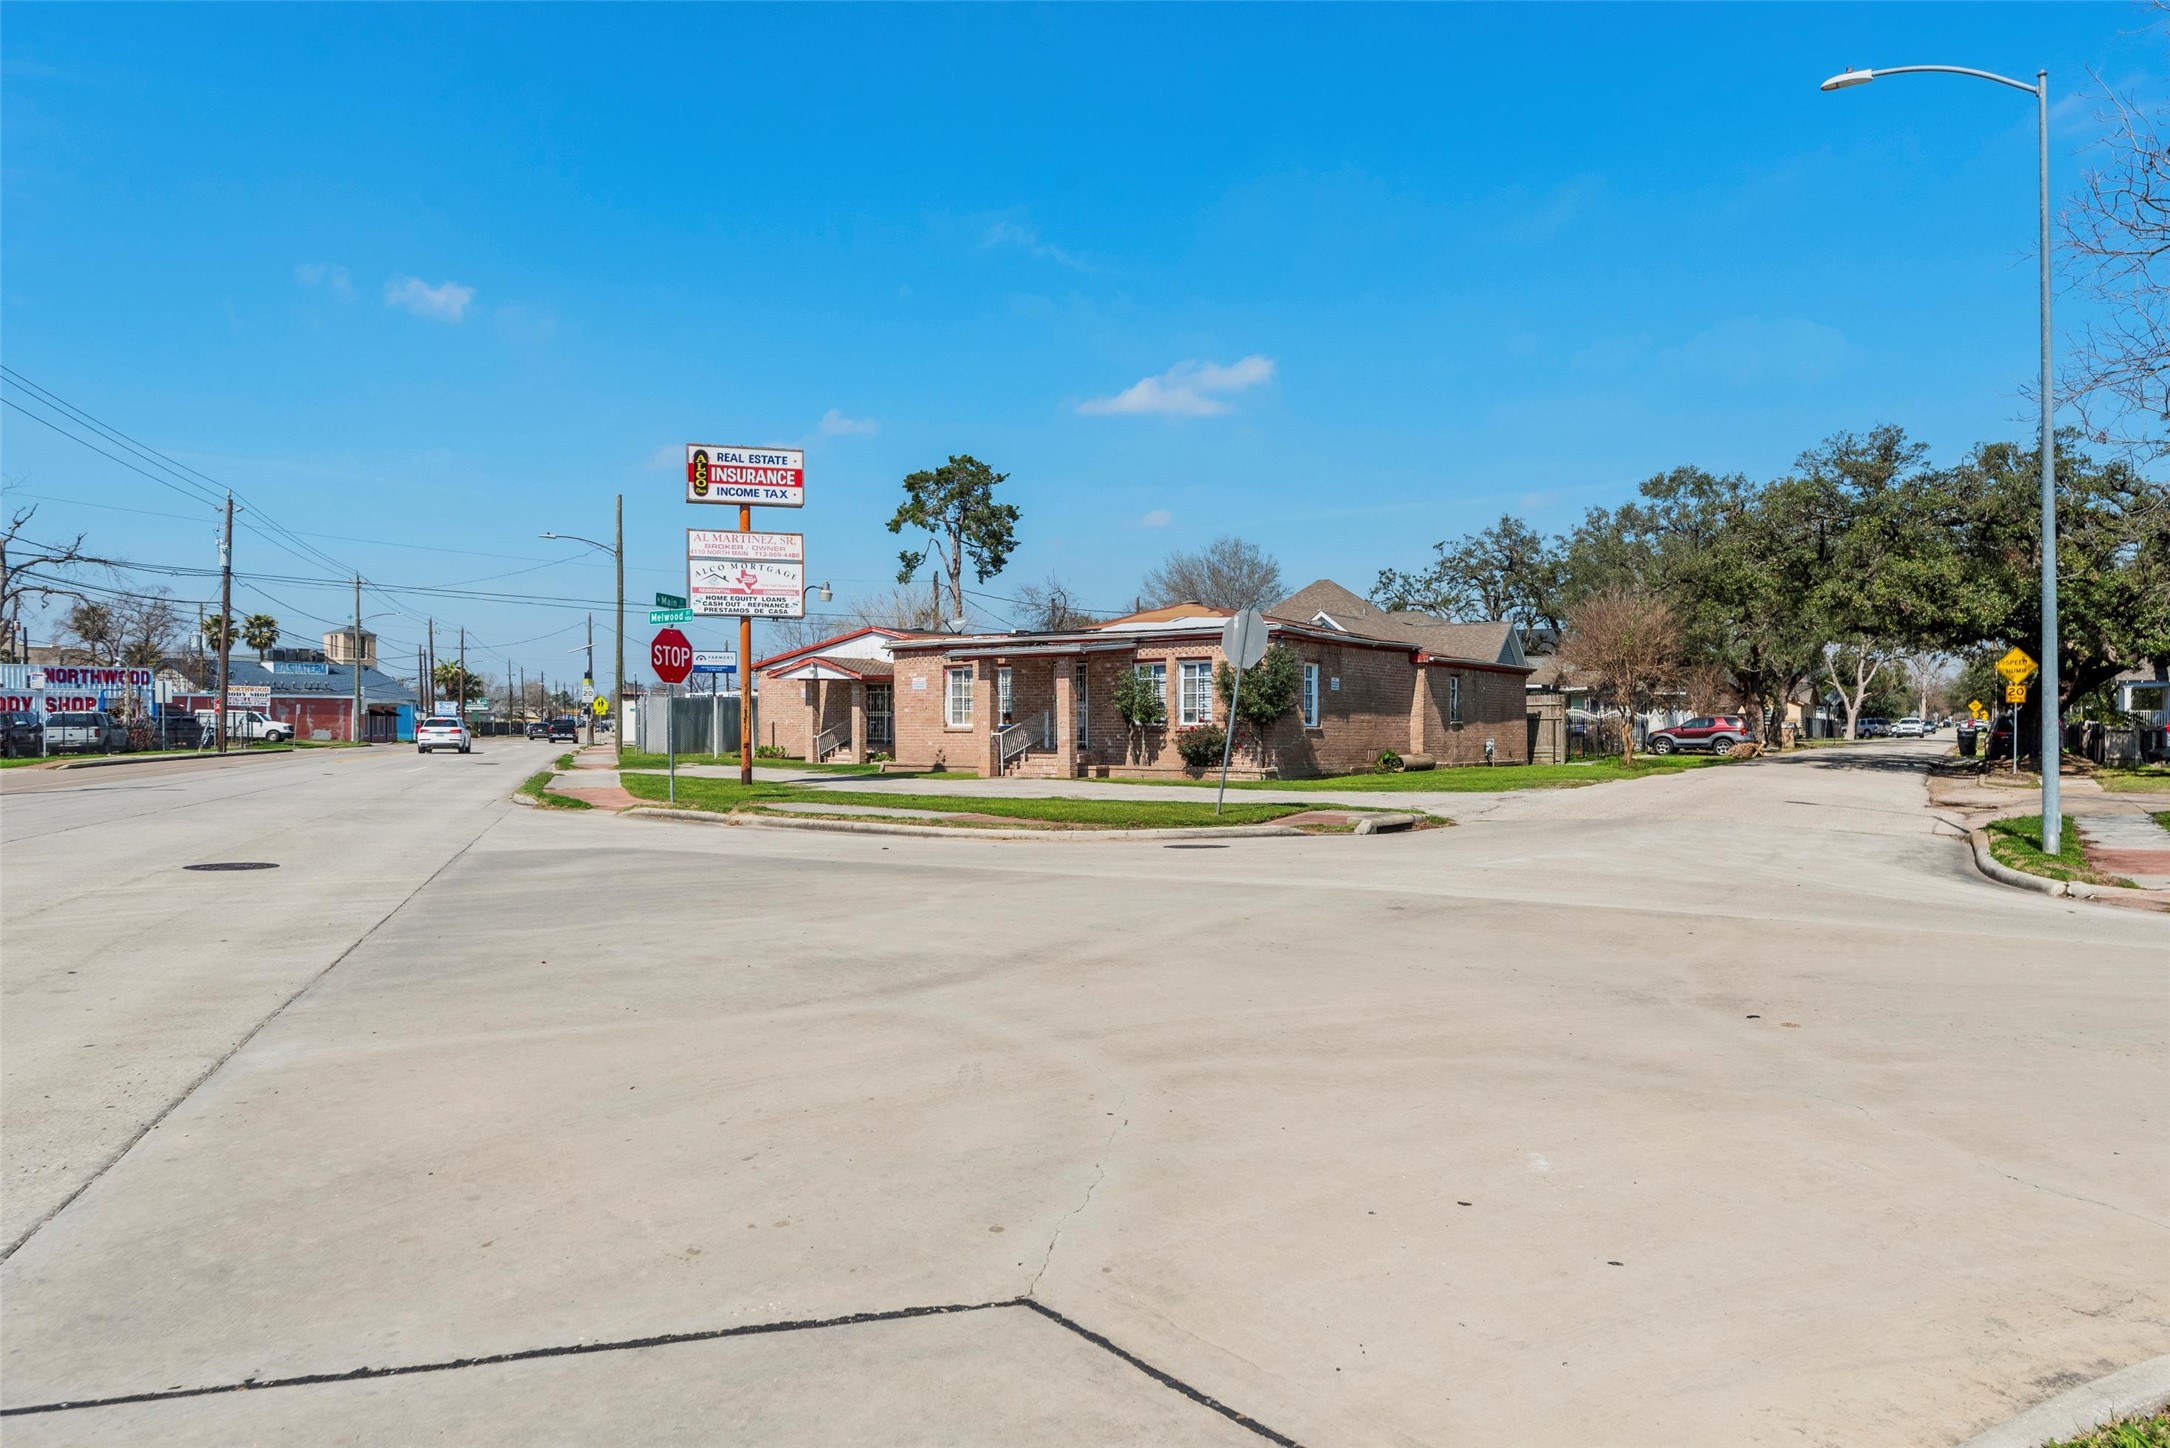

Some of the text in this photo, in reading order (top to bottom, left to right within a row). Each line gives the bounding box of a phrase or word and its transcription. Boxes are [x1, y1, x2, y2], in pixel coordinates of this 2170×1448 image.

[717, 452, 788, 465] REAL ESTATE
[695, 454, 707, 488] ALCO
[711, 467, 796, 485] INSURANCE
[716, 487, 760, 498] INCOME
[764, 489, 788, 499] TAX
[694, 533, 797, 546] AL MARTINEZ, SR.
[694, 564, 725, 578] ALCO
[730, 562, 798, 581] MORTGAGE
[661, 596, 677, 606] Main
[651, 612, 683, 622] Melwood
[654, 645, 690, 667] STOP
[44, 667, 150, 685] NORTHWOOD
[2008, 688, 2024, 696] 20
[46, 697, 97, 713] SHOP
